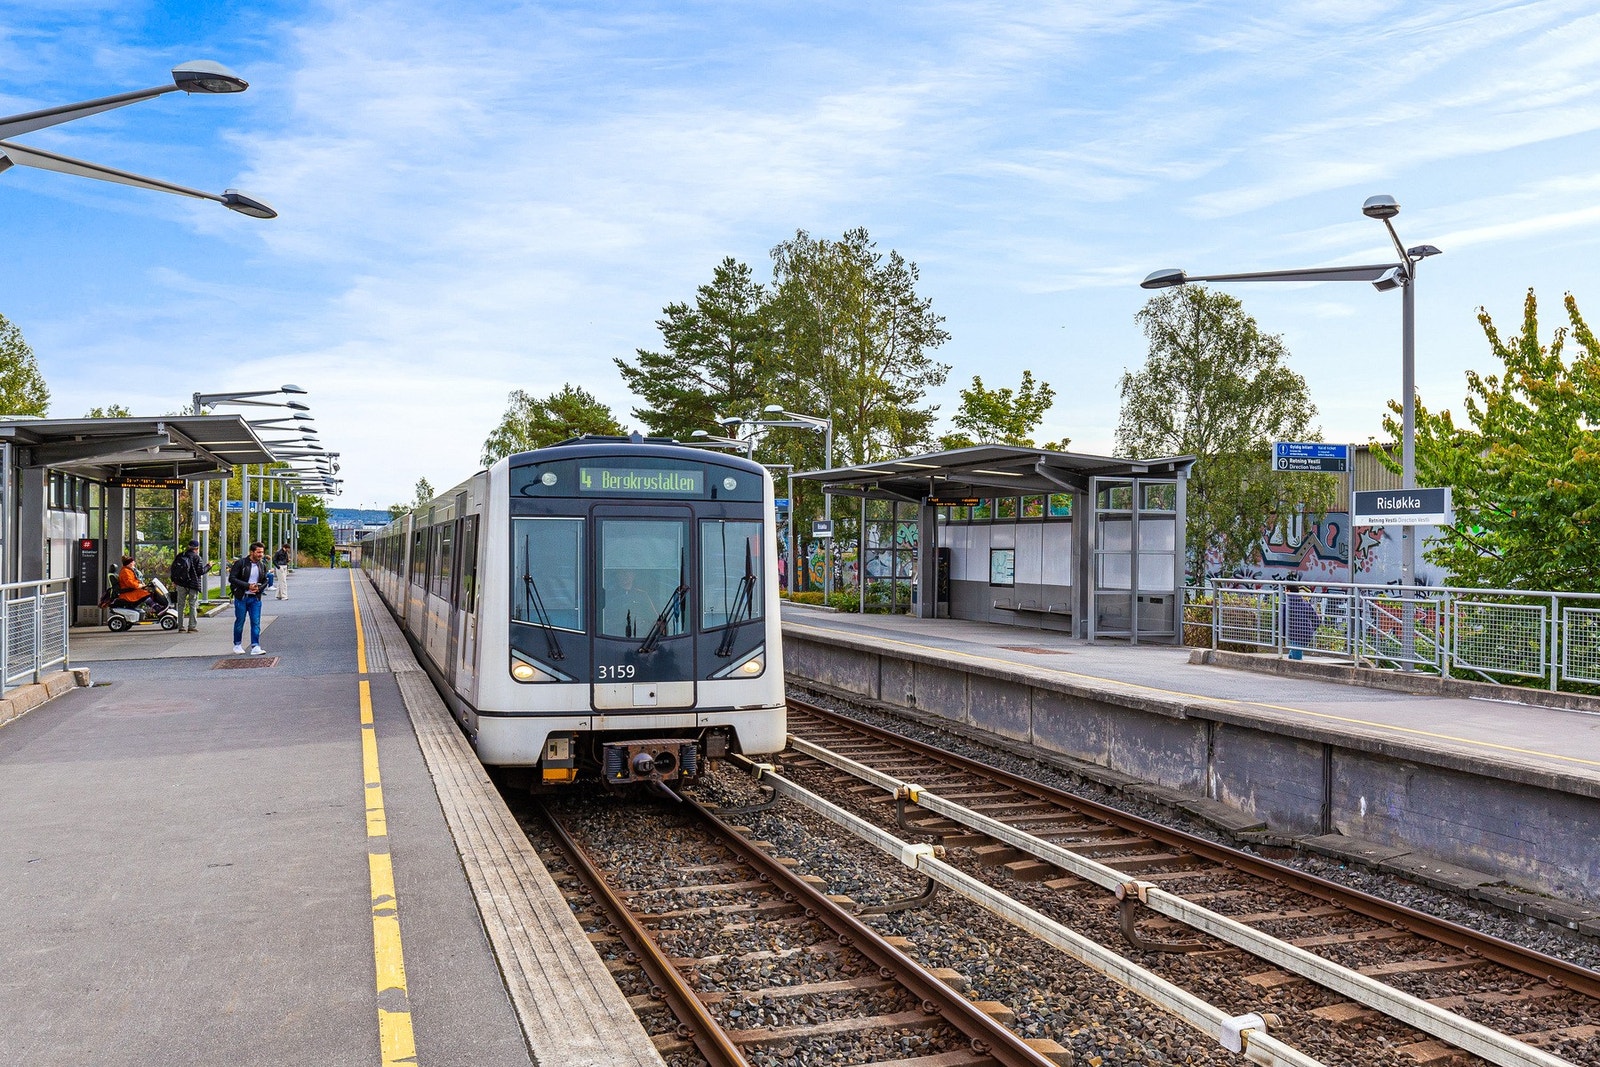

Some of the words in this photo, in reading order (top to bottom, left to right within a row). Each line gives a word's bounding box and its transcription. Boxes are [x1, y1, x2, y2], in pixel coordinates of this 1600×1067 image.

[581, 470, 592, 488] 4
[602, 470, 694, 490] Bergkrystallen
[1377, 496, 1420, 510] Risløkka
[598, 664, 635, 678] 3159
